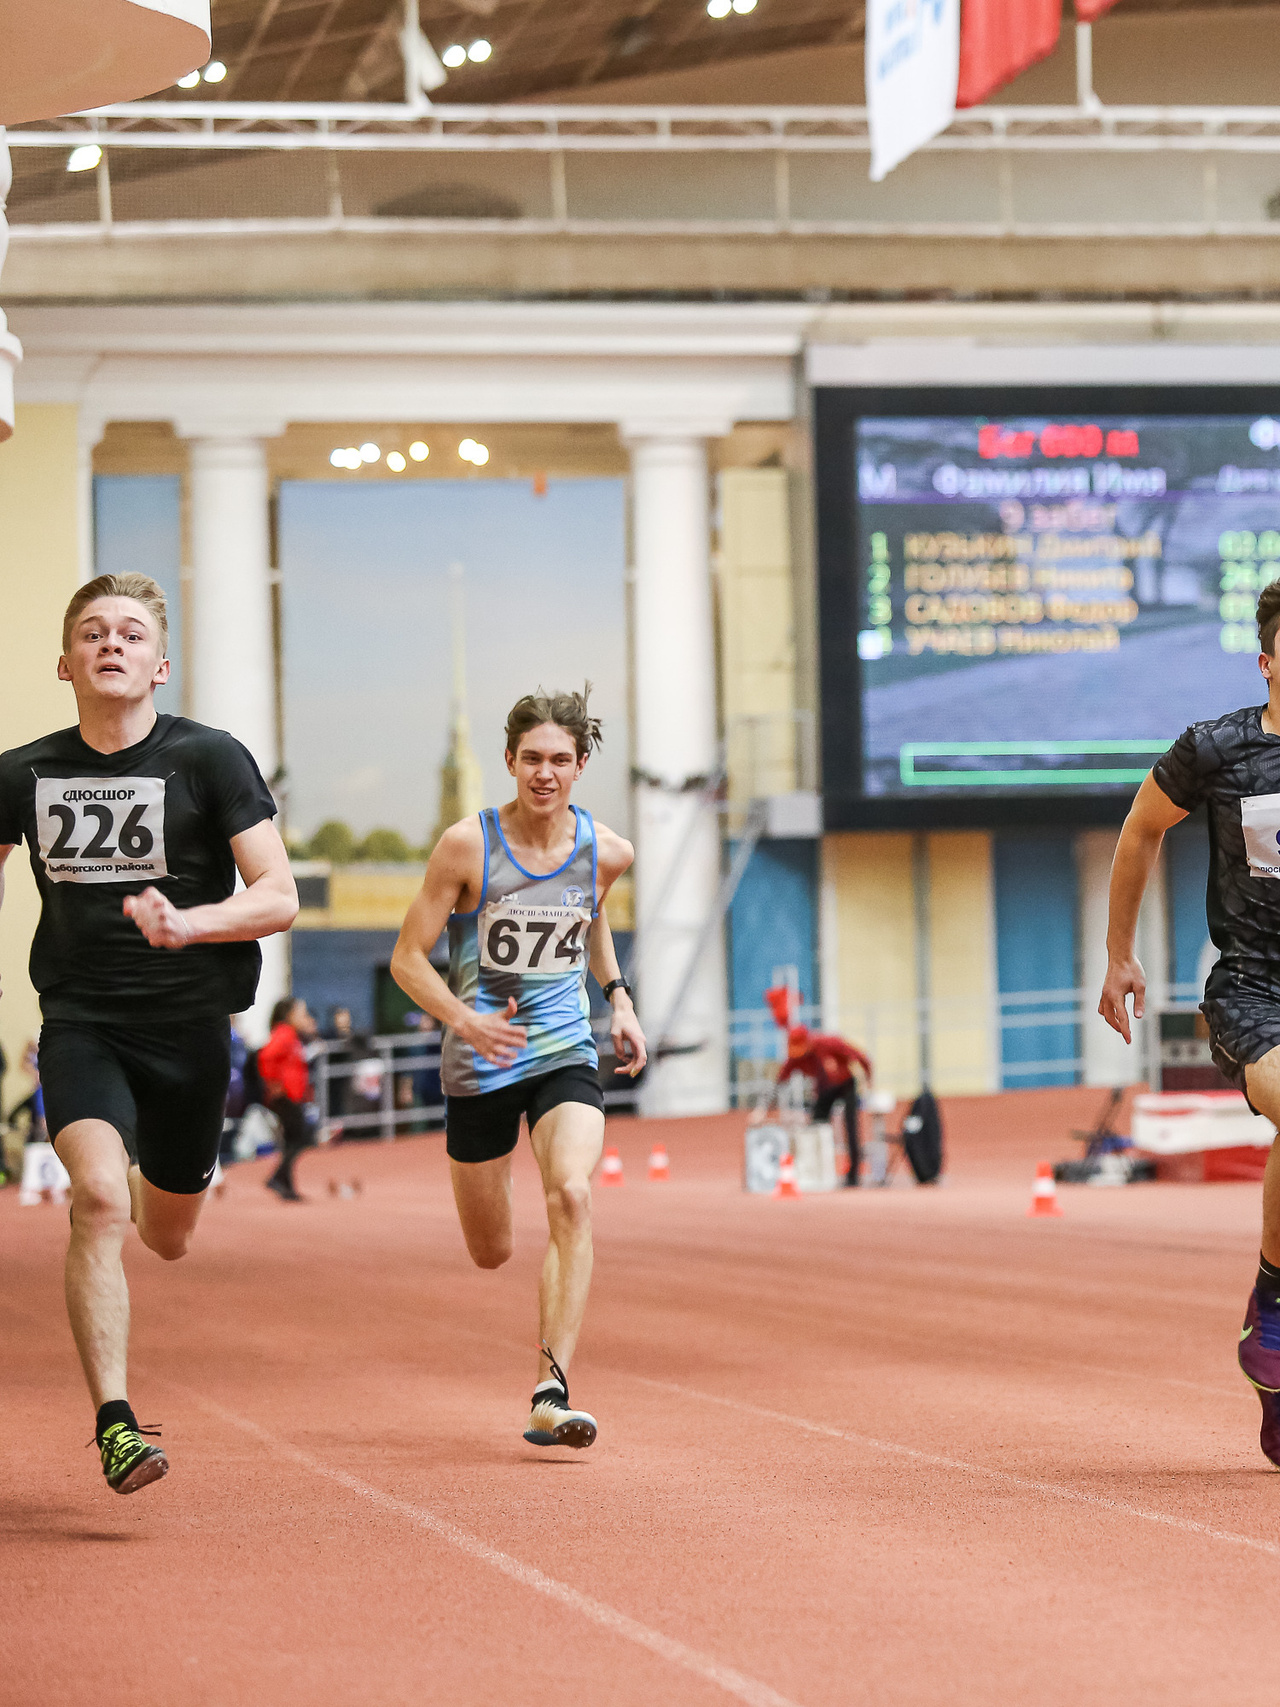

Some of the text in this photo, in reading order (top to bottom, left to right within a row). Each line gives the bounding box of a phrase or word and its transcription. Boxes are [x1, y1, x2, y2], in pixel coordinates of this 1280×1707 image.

[932, 464, 1089, 497] Фамилия
[1092, 462, 1166, 497] Имя
[871, 531, 888, 560] 1
[867, 563, 891, 592] 2
[868, 594, 892, 625] 3
[62, 789, 136, 802] СДЮСШОР
[46, 803, 154, 859] 226
[49, 862, 155, 874] ыборгского района
[487, 918, 583, 968] 674
